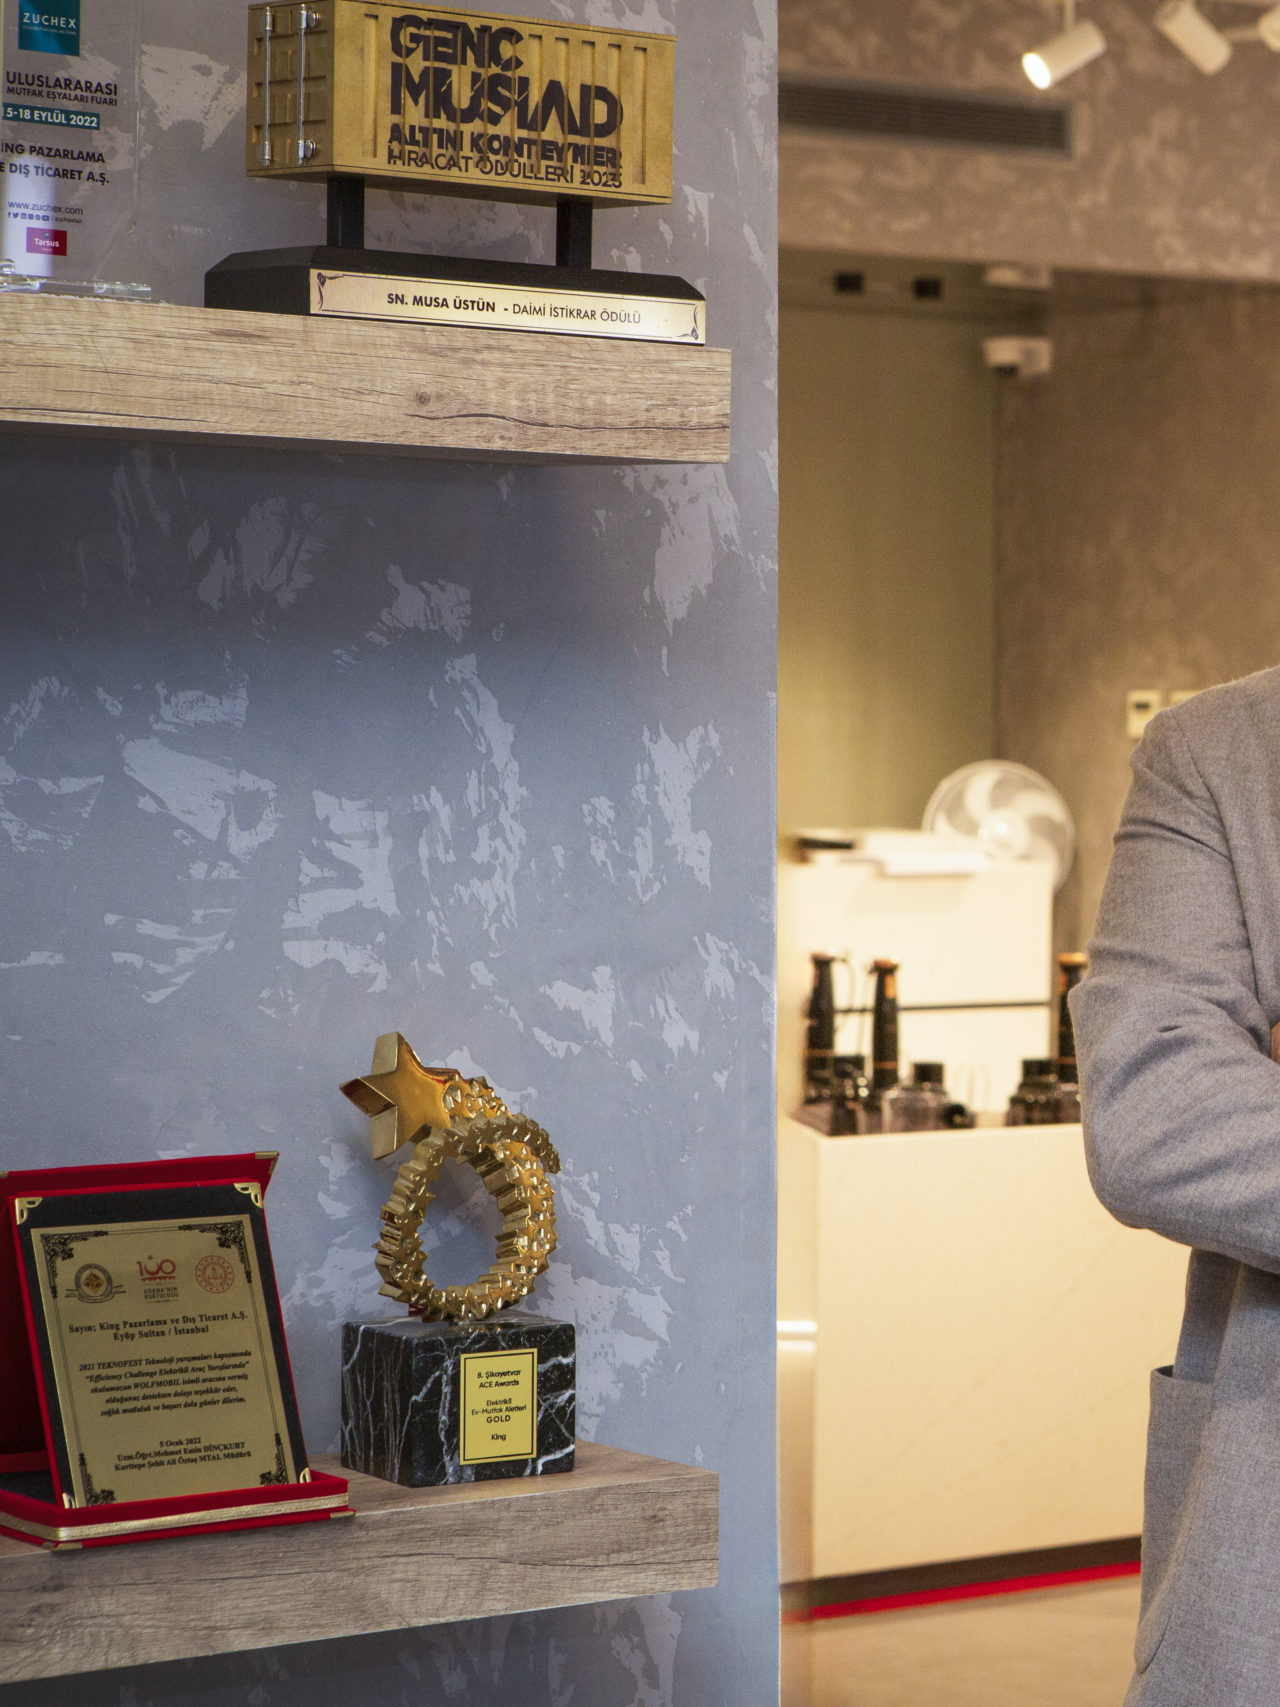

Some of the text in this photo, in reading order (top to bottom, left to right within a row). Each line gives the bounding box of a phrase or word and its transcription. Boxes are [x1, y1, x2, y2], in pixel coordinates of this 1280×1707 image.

[23, 12, 77, 28] ZUCHEX
[6, 71, 118, 96] ULUSLARARASI
[7, 86, 118, 107] MUTFAK EŞYALARI FUARI
[34, 109, 67, 124] EYLÜL
[70, 114, 98, 127] 2022
[388, 123, 622, 169] ALTIN KONTEYNER
[29, 145, 105, 164] PAZARLAMA
[9, 163, 30, 178] DIŞ
[33, 164, 83, 180] TİCARET
[86, 171, 110, 186] A.Ş.
[475, 155, 574, 184] ÖDÜLLERİ
[8, 201, 83, 215] www.zuchex.com
[34, 237, 60, 248] Tarsus
[387, 293, 408, 305] SN.
[412, 295, 449, 309] MUSA
[453, 296, 496, 312] ÜSTÜN
[512, 302, 546, 317] DAİMİ
[549, 304, 597, 321] İSTİKRAR
[600, 308, 641, 324] ÖDÜLÜ
[99, 1322, 120, 1331] King
[123, 1319, 167, 1329] Pazarlama
[182, 1315, 196, 1324] Dış
[198, 1313, 228, 1322] Ticaret
[231, 1310, 248, 1320] A.Ş.
[113, 1332, 135, 1342] Eyüp
[138, 1329, 165, 1339] Sultan
[174, 1325, 209, 1335] İstanbul
[97, 1359, 142, 1369] TEKNOFEST
[124, 1370, 157, 1379] Challenge
[485, 1370, 521, 1380] Şikayetvar
[495, 1379, 520, 1388] Awards
[471, 1407, 503, 1416] Ev-Mutfak
[486, 1415, 511, 1423] GOLD
[165, 1439, 184, 1447] Ocak
